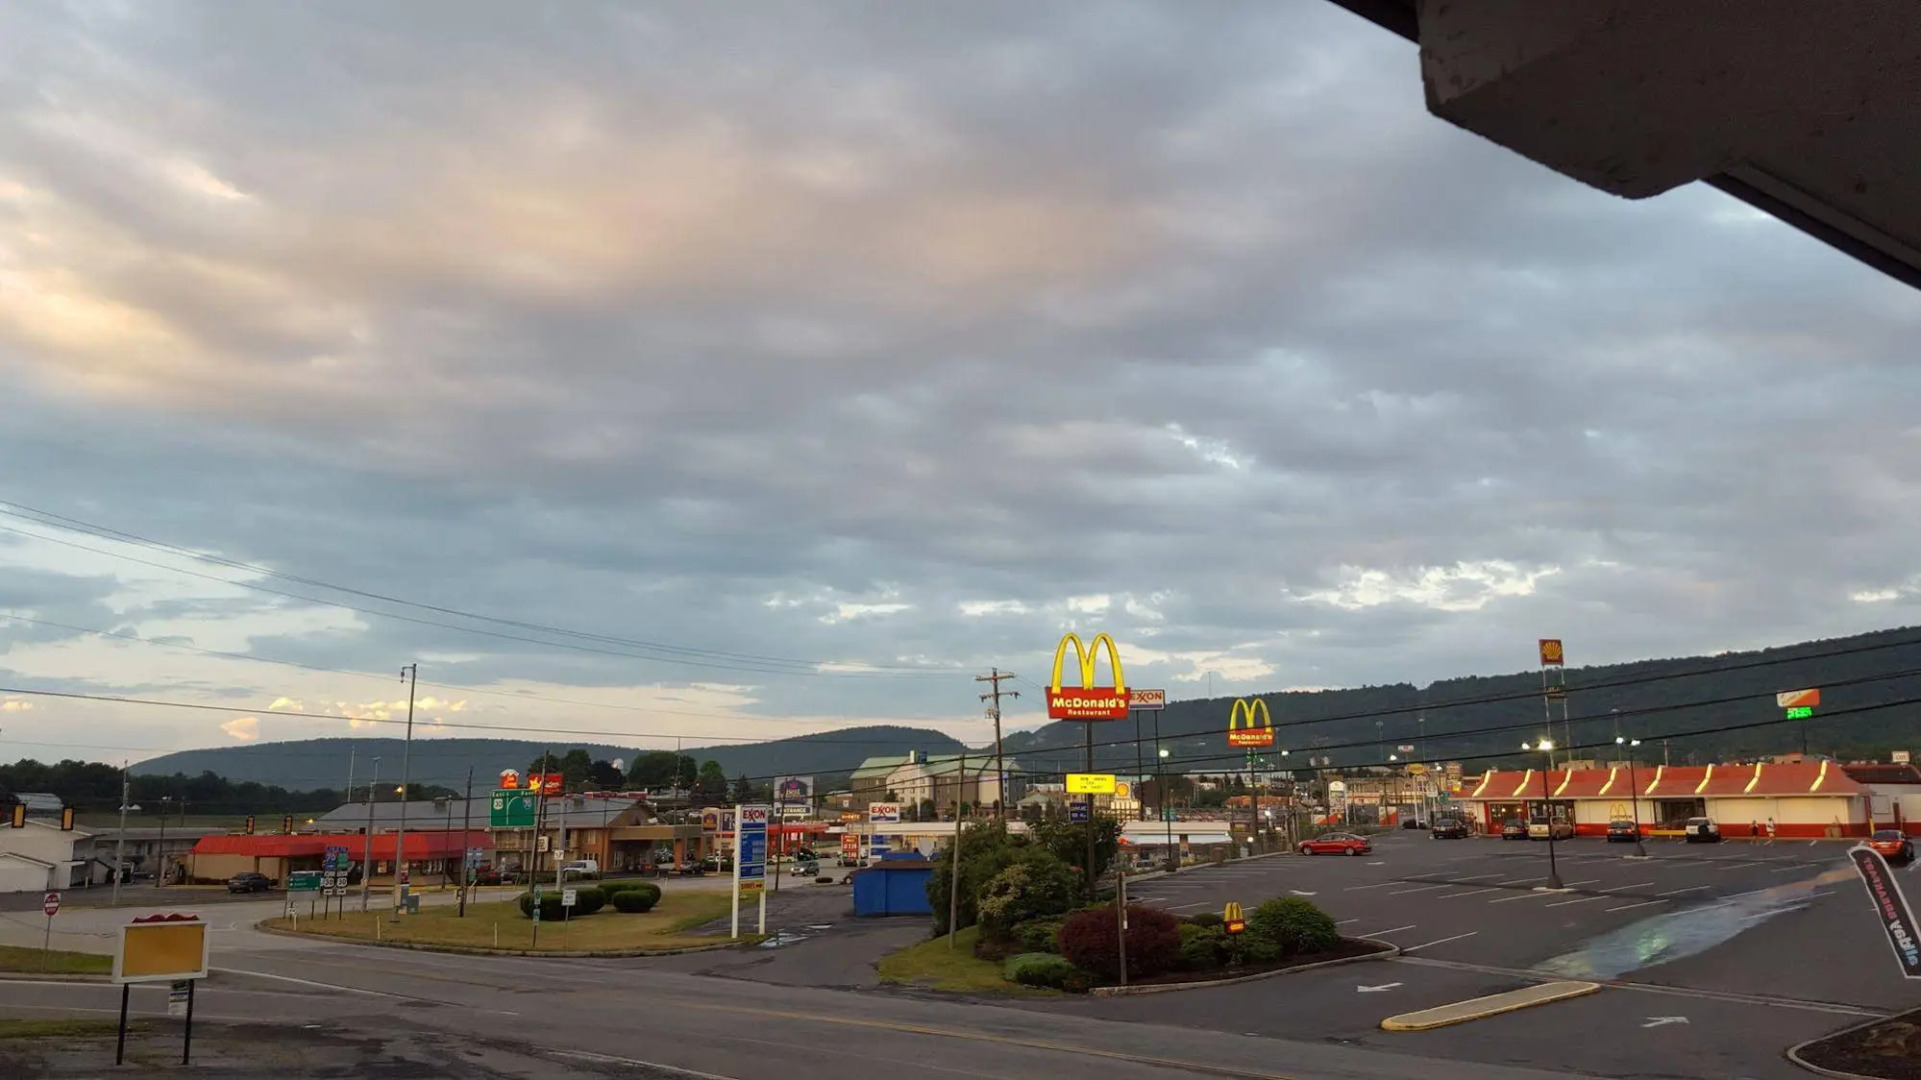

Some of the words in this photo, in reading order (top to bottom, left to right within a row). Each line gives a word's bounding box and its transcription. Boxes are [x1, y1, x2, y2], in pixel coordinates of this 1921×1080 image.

[1052, 697, 1126, 708] McDonald's
[1130, 692, 1162, 703] EXXON
[1229, 733, 1273, 741] McDonald's
[742, 808, 766, 822] EXXON
[871, 805, 897, 817] EXXON
